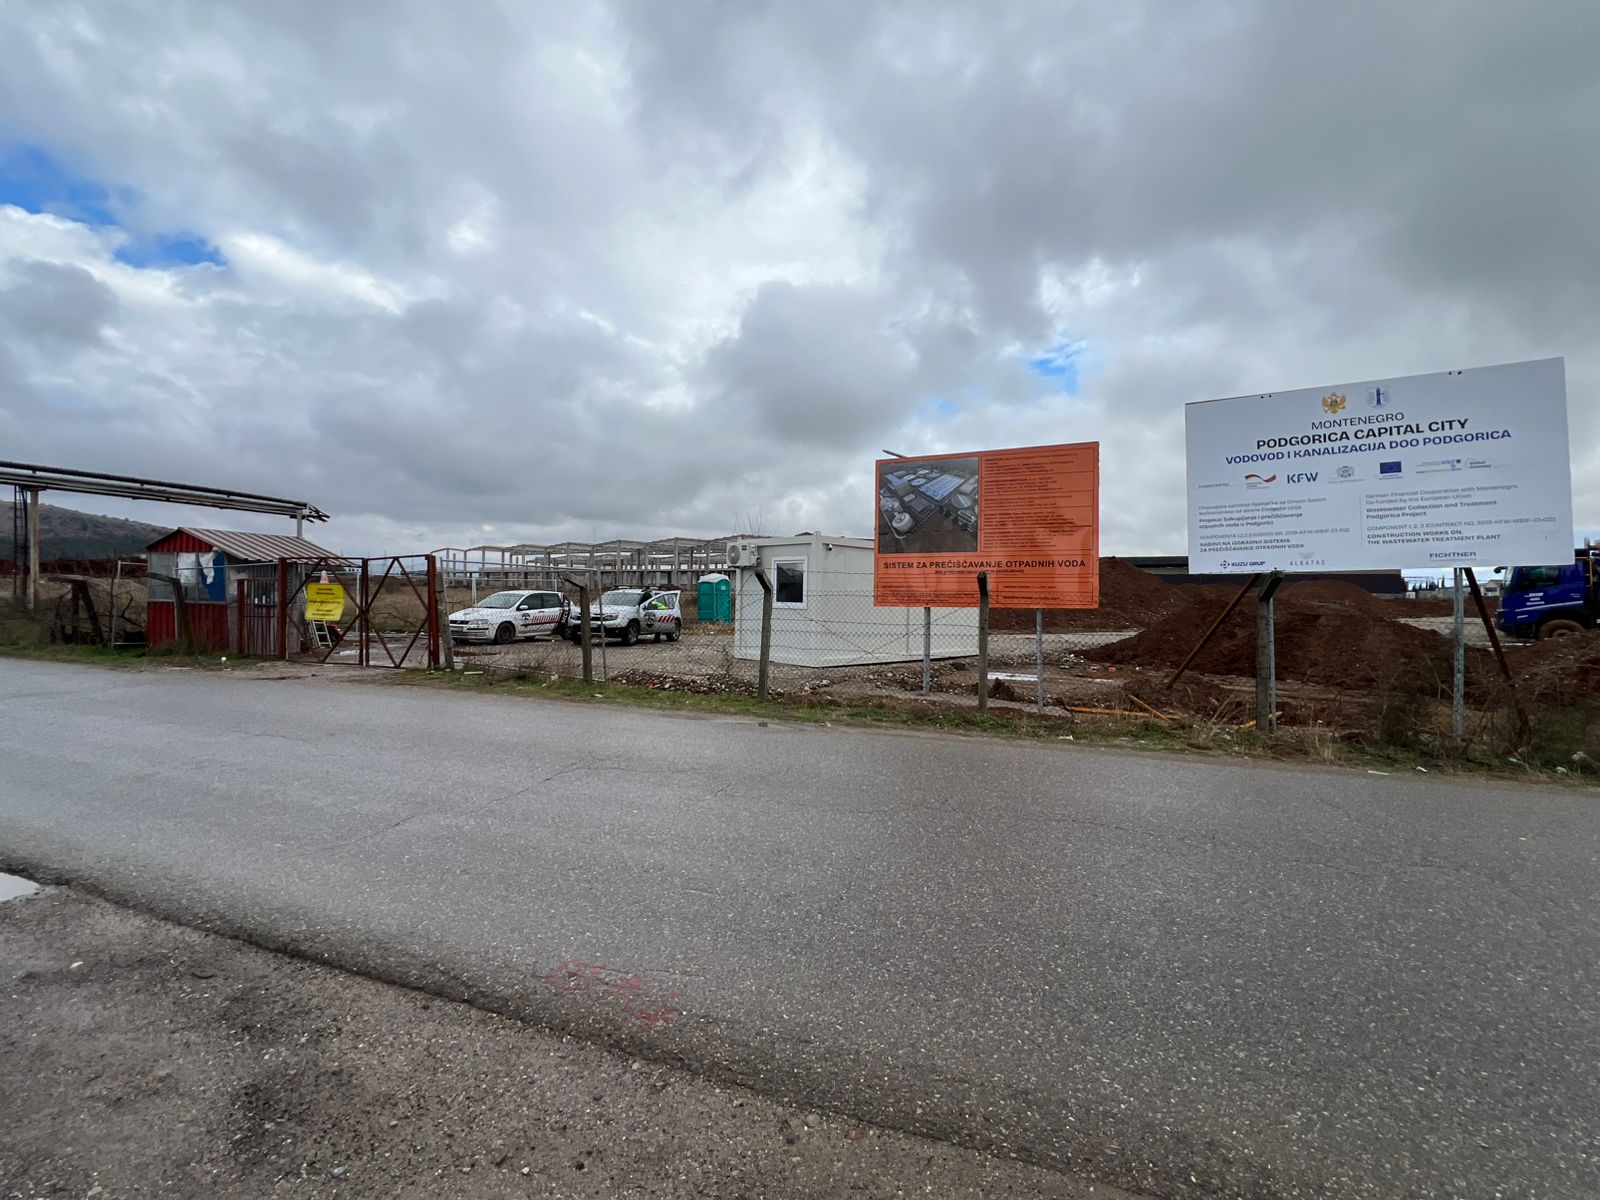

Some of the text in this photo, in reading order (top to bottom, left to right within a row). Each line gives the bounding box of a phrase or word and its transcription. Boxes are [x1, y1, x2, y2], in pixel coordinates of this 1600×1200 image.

[1311, 412, 1404, 430] MONTENEGRO
[1256, 418, 1469, 450] PODGORICA CAPITAL CITY
[1226, 430, 1512, 464] VODOVOD I KANALIZACIJA DOO PODGORICA
[1287, 472, 1318, 484] KFW
[1058, 560, 1086, 568] VODA
